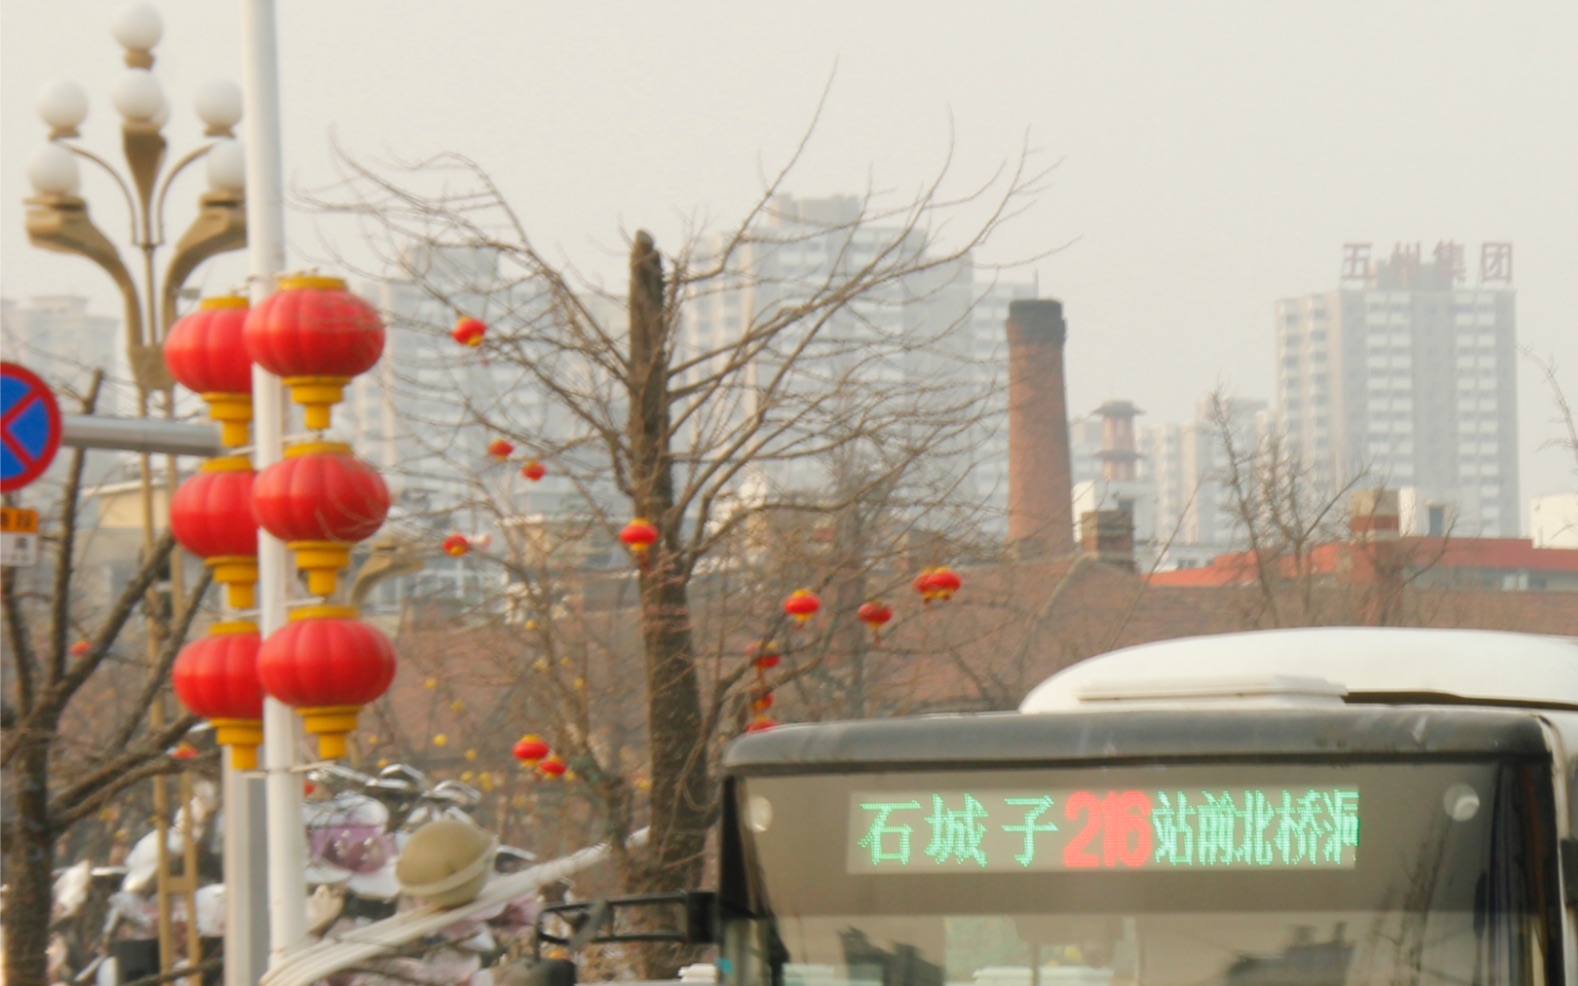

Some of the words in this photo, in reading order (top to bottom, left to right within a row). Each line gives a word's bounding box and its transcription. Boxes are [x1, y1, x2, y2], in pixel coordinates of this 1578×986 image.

[858, 793, 1060, 868] 石城子
[1063, 790, 1152, 869] 216
